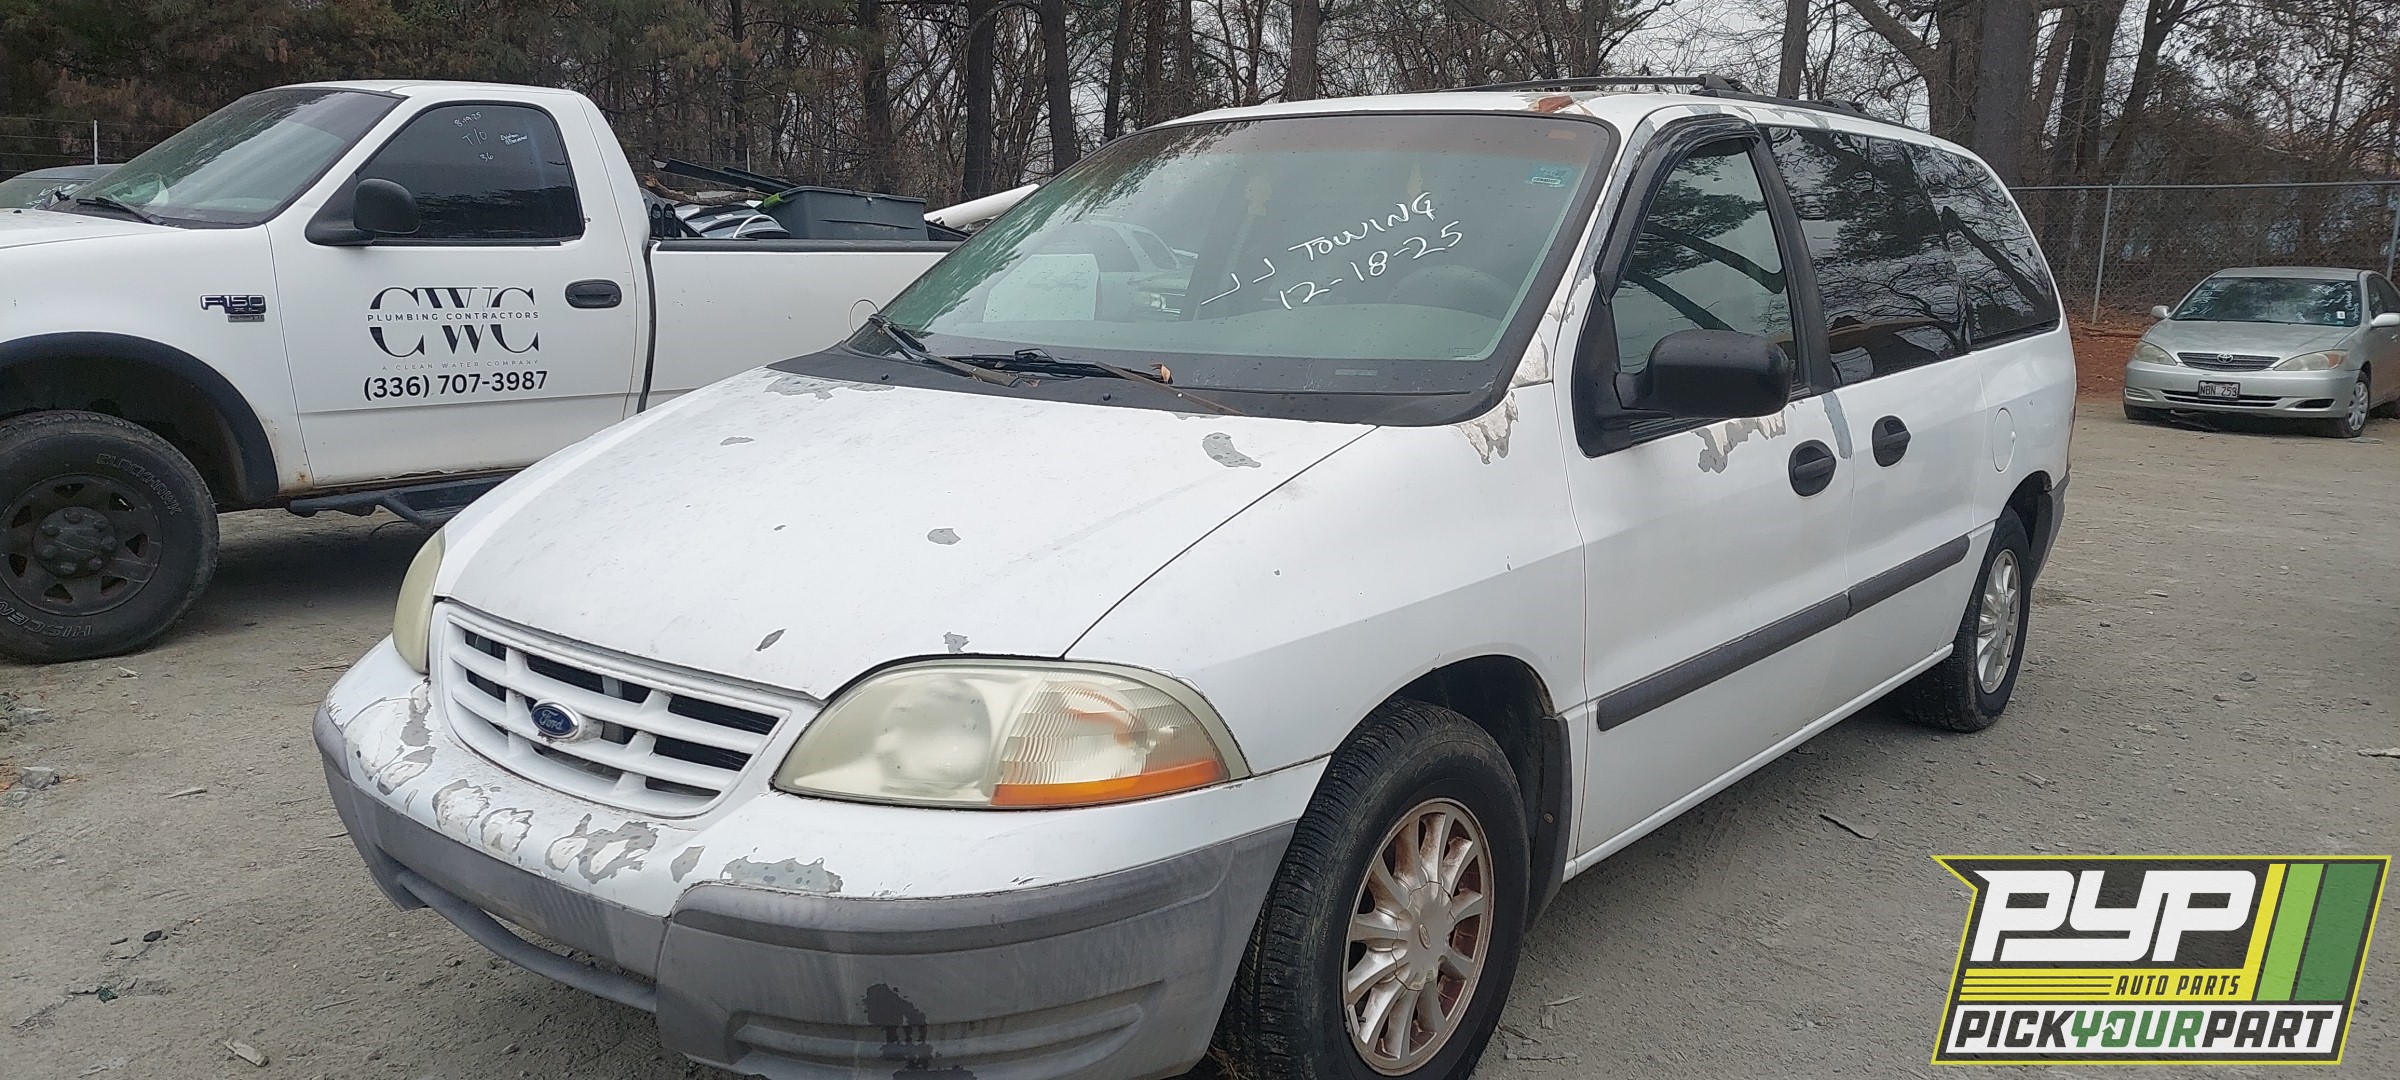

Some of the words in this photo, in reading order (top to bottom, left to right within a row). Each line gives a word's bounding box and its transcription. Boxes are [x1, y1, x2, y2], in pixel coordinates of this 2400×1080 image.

[1288, 192, 1436, 261] TOWING
[1280, 220, 1462, 310] 12-18-25
[367, 313, 439, 322] PLUMBING
[446, 311, 539, 321] CONTRACTORS
[369, 287, 540, 358] CWC
[396, 363, 434, 371] CLEAN
[486, 359, 539, 367] COMPANY
[364, 374, 430, 401] (336)
[437, 371, 548, 395] 707-3987
[539, 709, 565, 731] Ford
